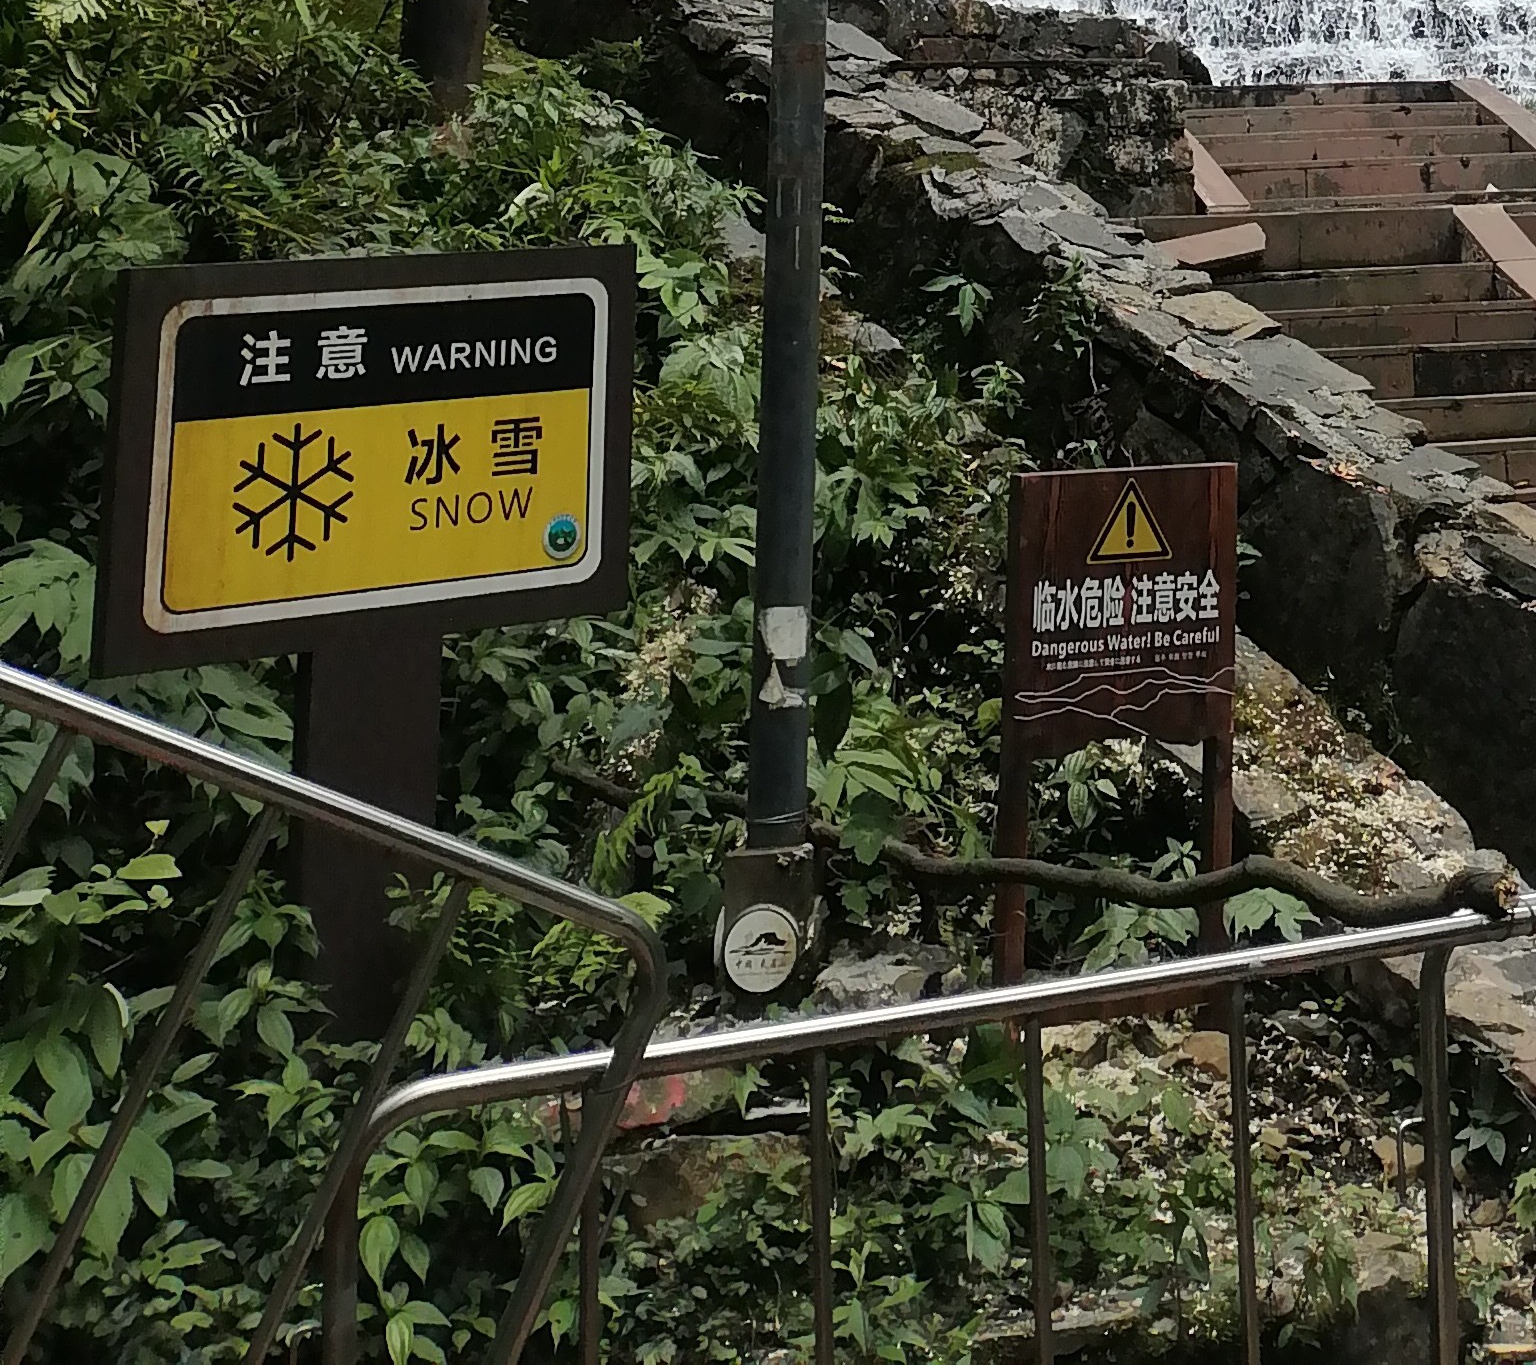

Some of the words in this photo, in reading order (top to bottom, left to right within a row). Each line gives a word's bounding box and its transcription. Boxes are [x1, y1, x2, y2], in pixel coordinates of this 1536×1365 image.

[239, 325, 369, 387] 注意
[390, 336, 558, 374] WARNING
[404, 415, 543, 486] 冰雪
[409, 486, 534, 531] SNOW
[1032, 574, 1125, 634] 临水危险
[1130, 568, 1221, 626] 注意安全
[1031, 639, 1105, 660] Dangerous
[1107, 631, 1152, 651] Water!
[1154, 631, 1171, 648] Be
[1173, 625, 1221, 646] Careful
